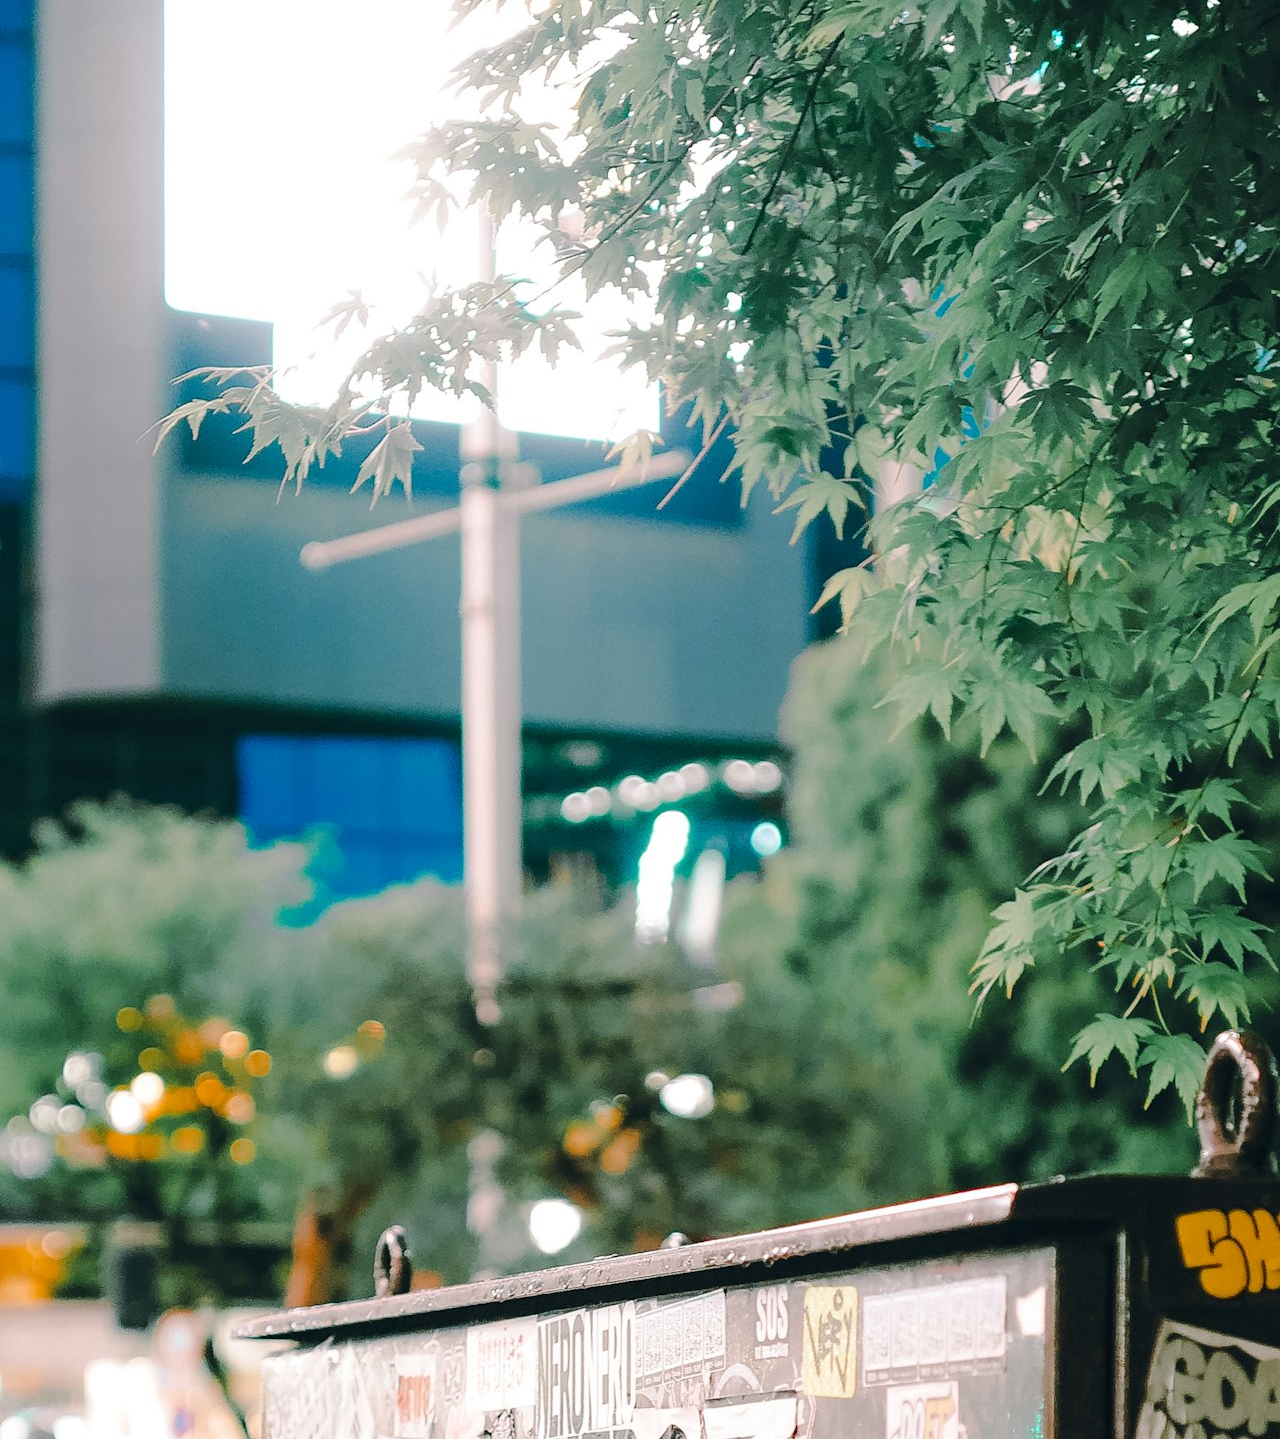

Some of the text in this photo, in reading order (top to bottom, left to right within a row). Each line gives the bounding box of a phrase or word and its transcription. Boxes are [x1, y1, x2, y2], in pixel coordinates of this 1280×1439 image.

[755, 1286, 789, 1343] SOS
[537, 1318, 587, 1439] NERO
[588, 1299, 636, 1431] NERO
